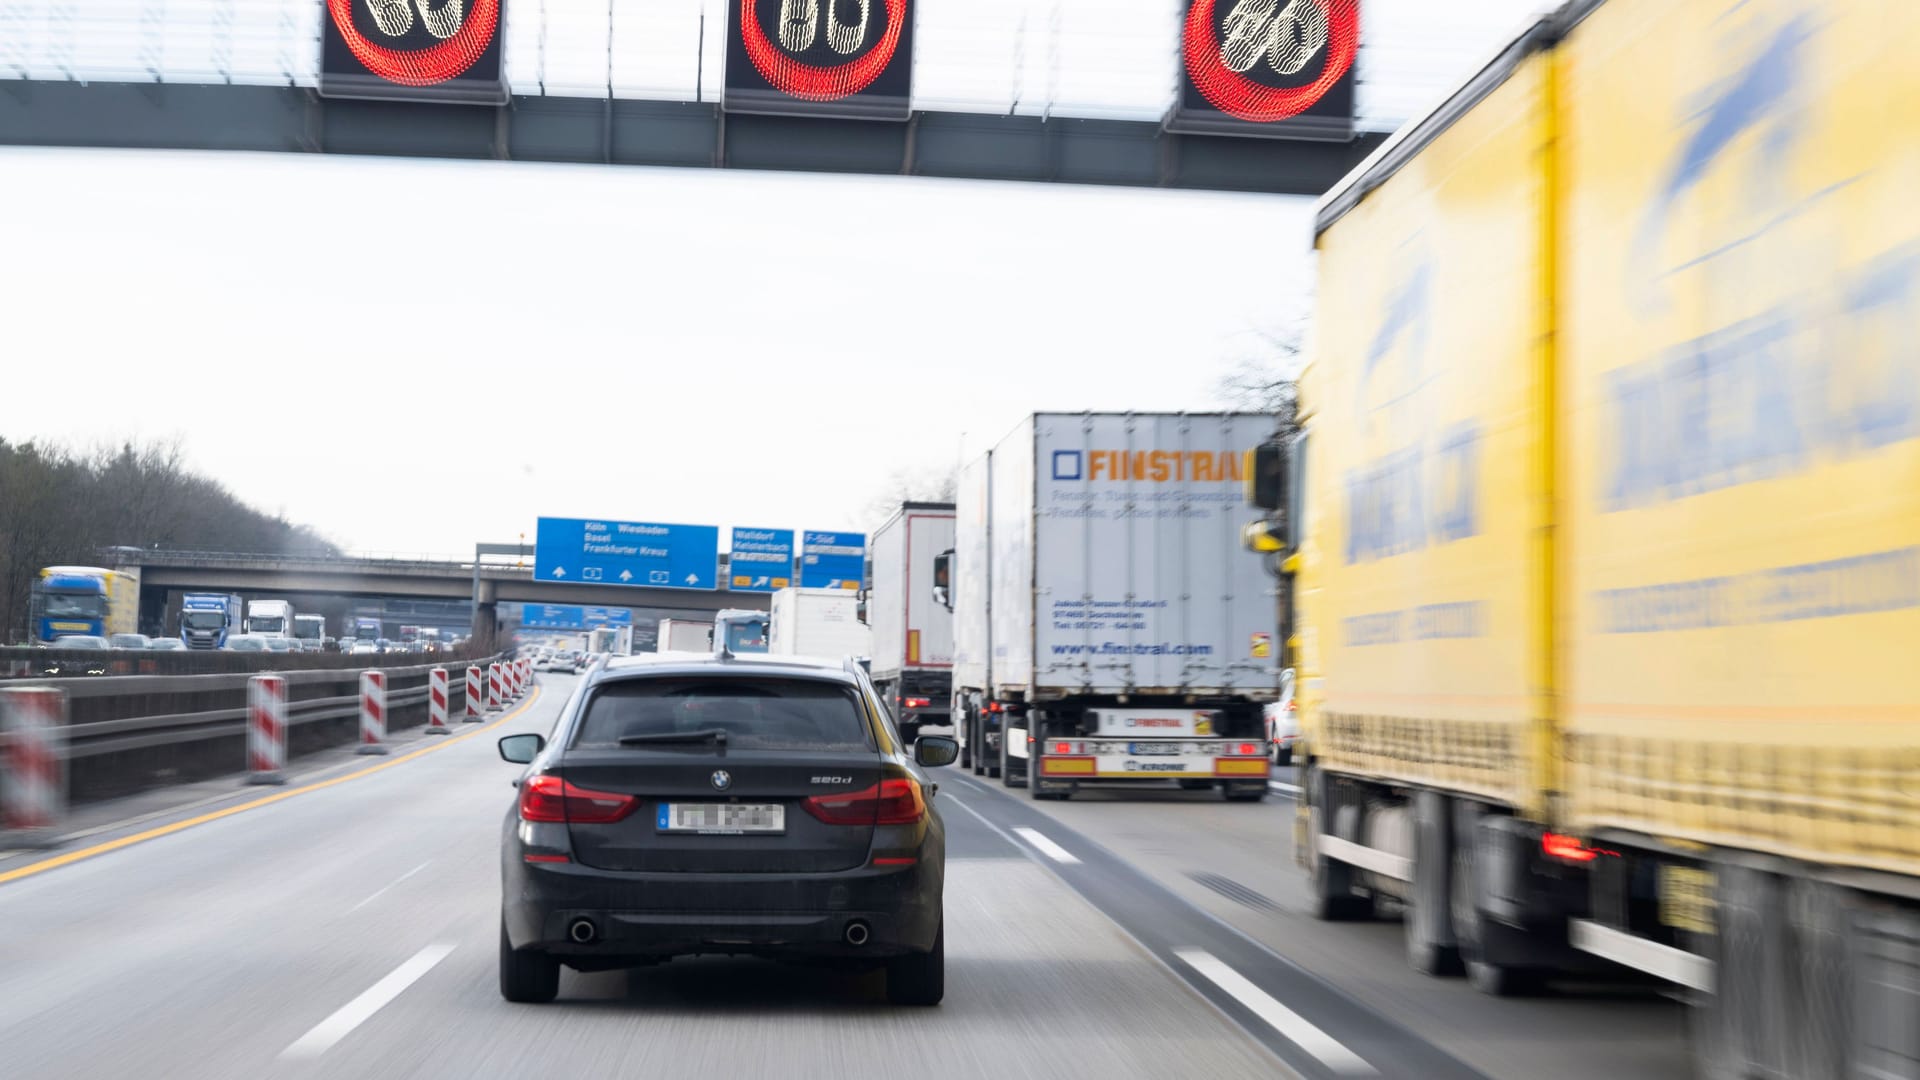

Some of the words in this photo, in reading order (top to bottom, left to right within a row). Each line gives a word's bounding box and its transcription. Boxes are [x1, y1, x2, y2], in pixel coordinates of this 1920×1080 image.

[584, 521, 607, 531] Köln
[618, 524, 669, 535] Wiesbaden
[584, 532, 611, 542] Basel
[583, 543, 638, 554] Frankfurter
[639, 546, 668, 557] Kreuz
[1051, 642, 1213, 655] www.finstral.com
